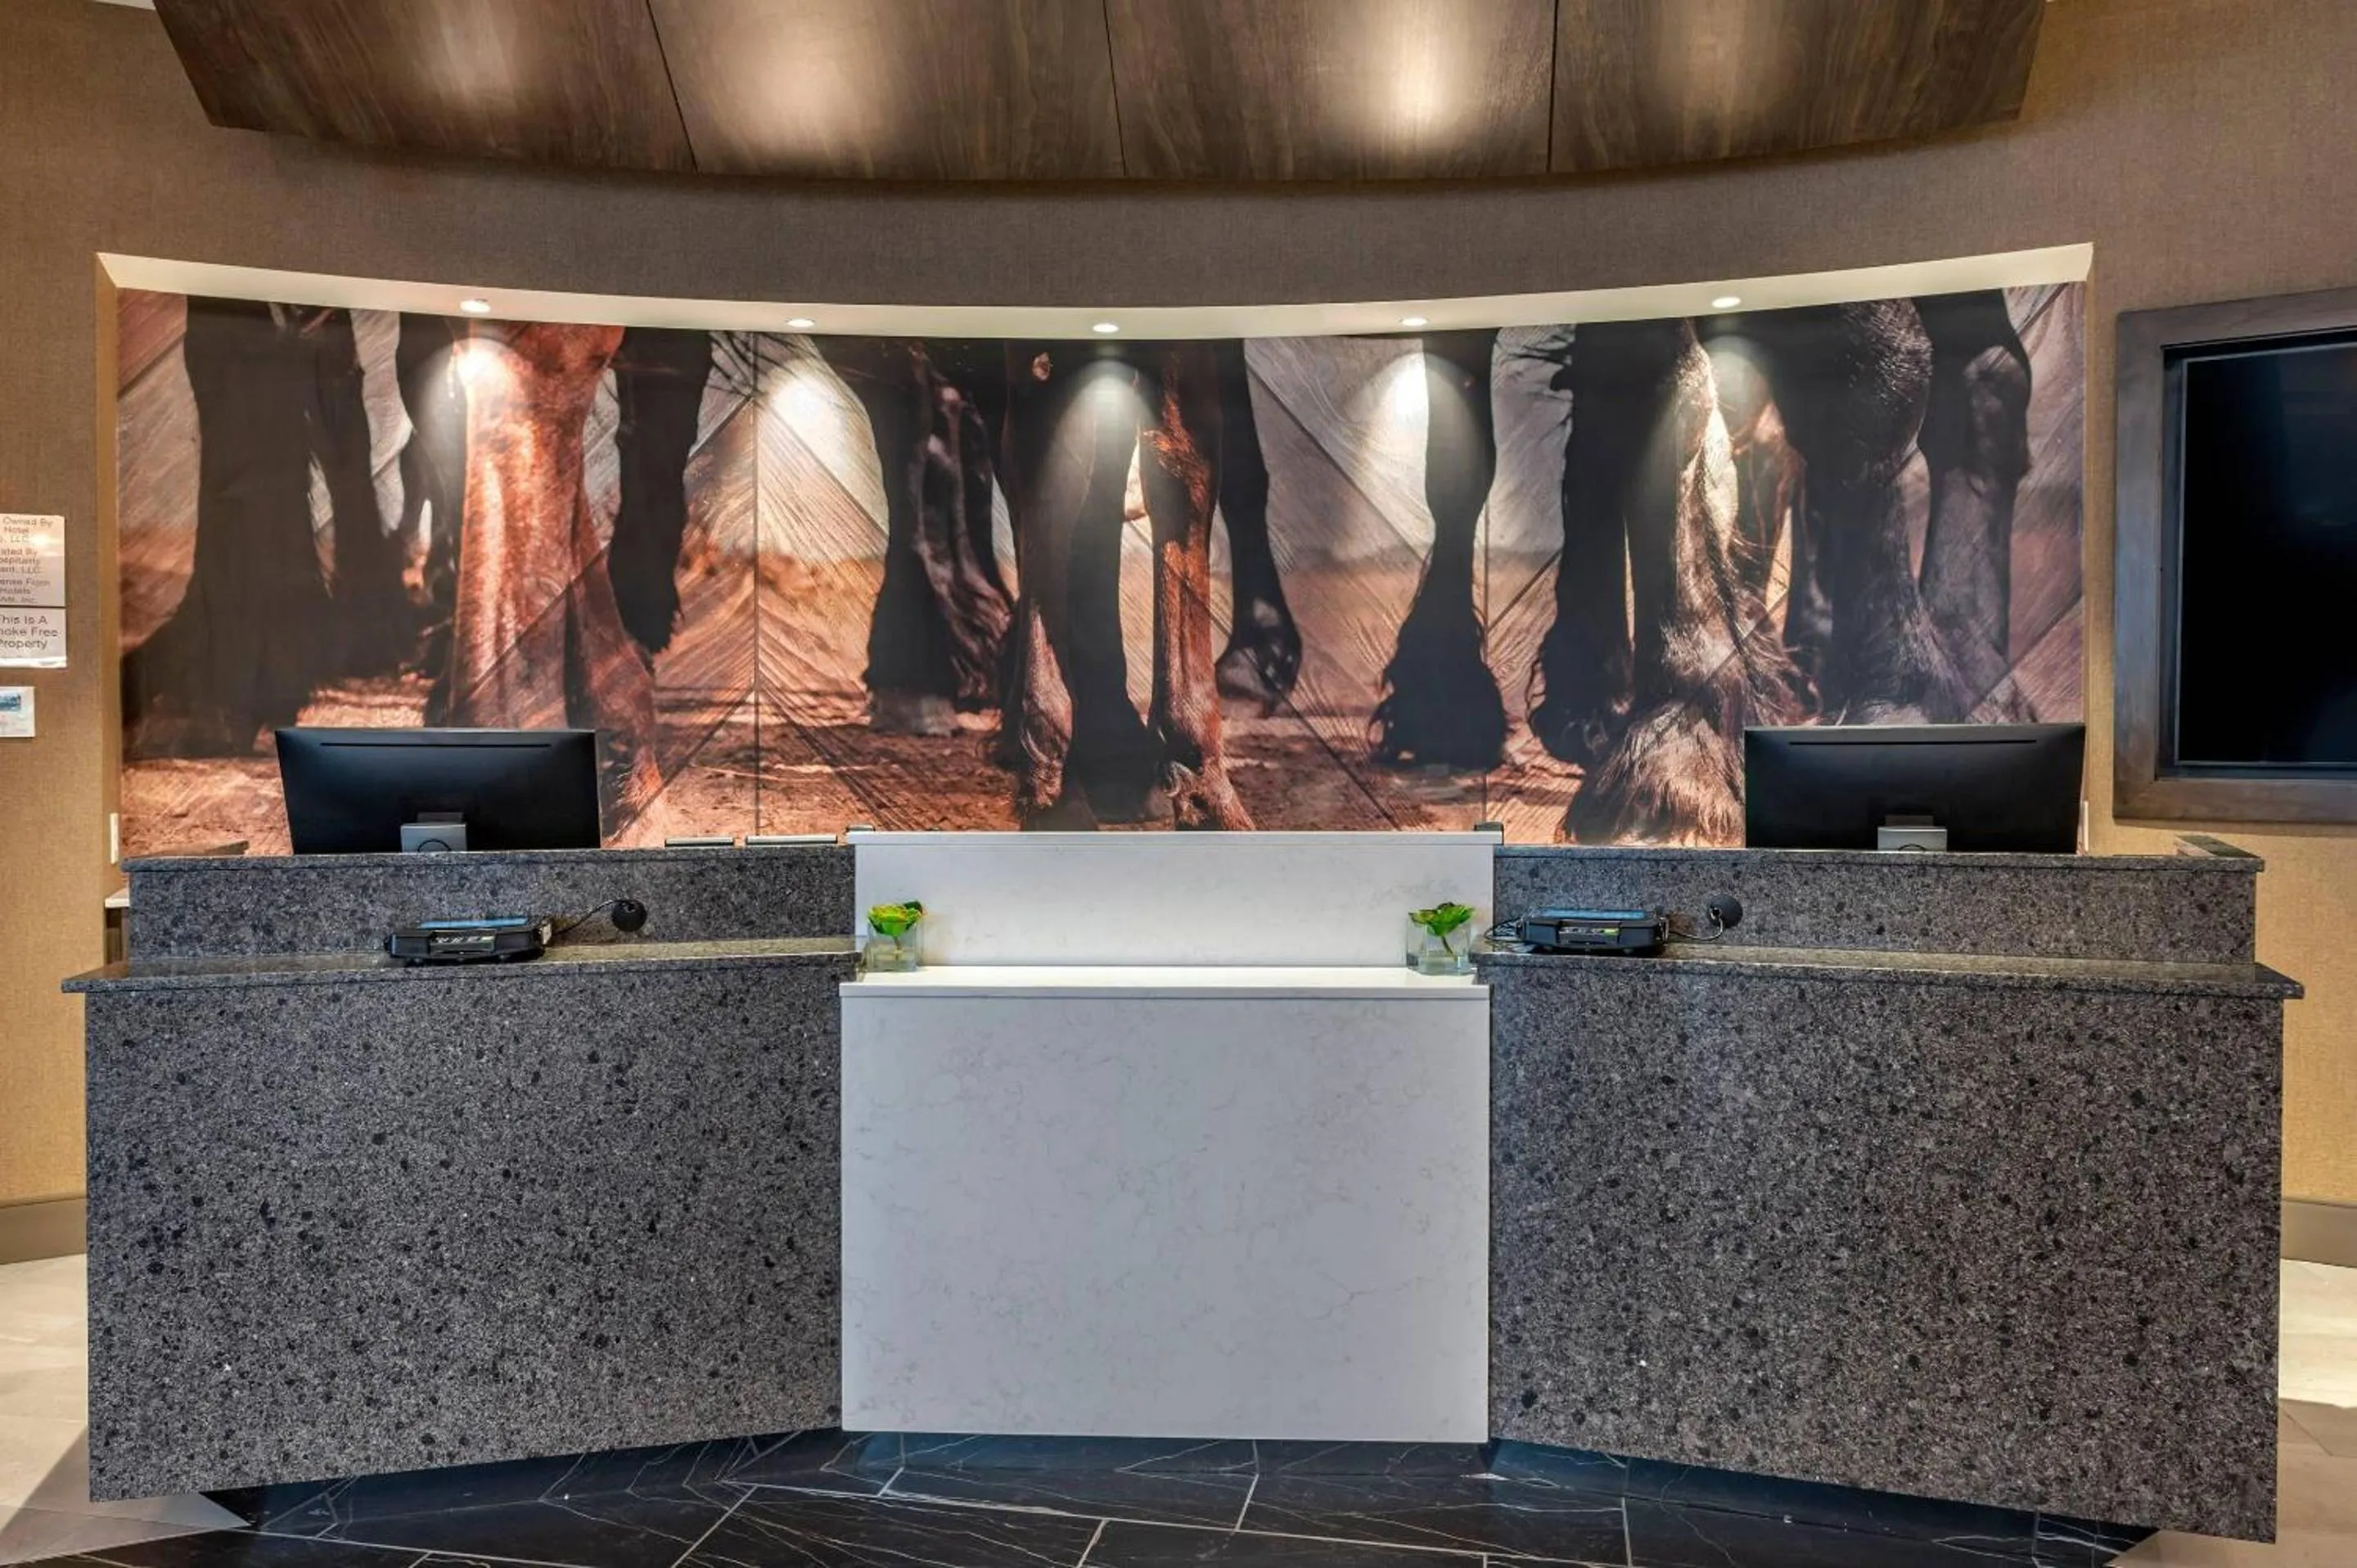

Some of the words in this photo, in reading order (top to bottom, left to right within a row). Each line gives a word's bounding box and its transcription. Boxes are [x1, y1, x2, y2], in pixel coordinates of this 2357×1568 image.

[3, 516, 37, 525] Owned
[40, 517, 53, 527] By
[25, 615, 35, 624] Is
[38, 615, 49, 624] A
[31, 627, 58, 637] Free
